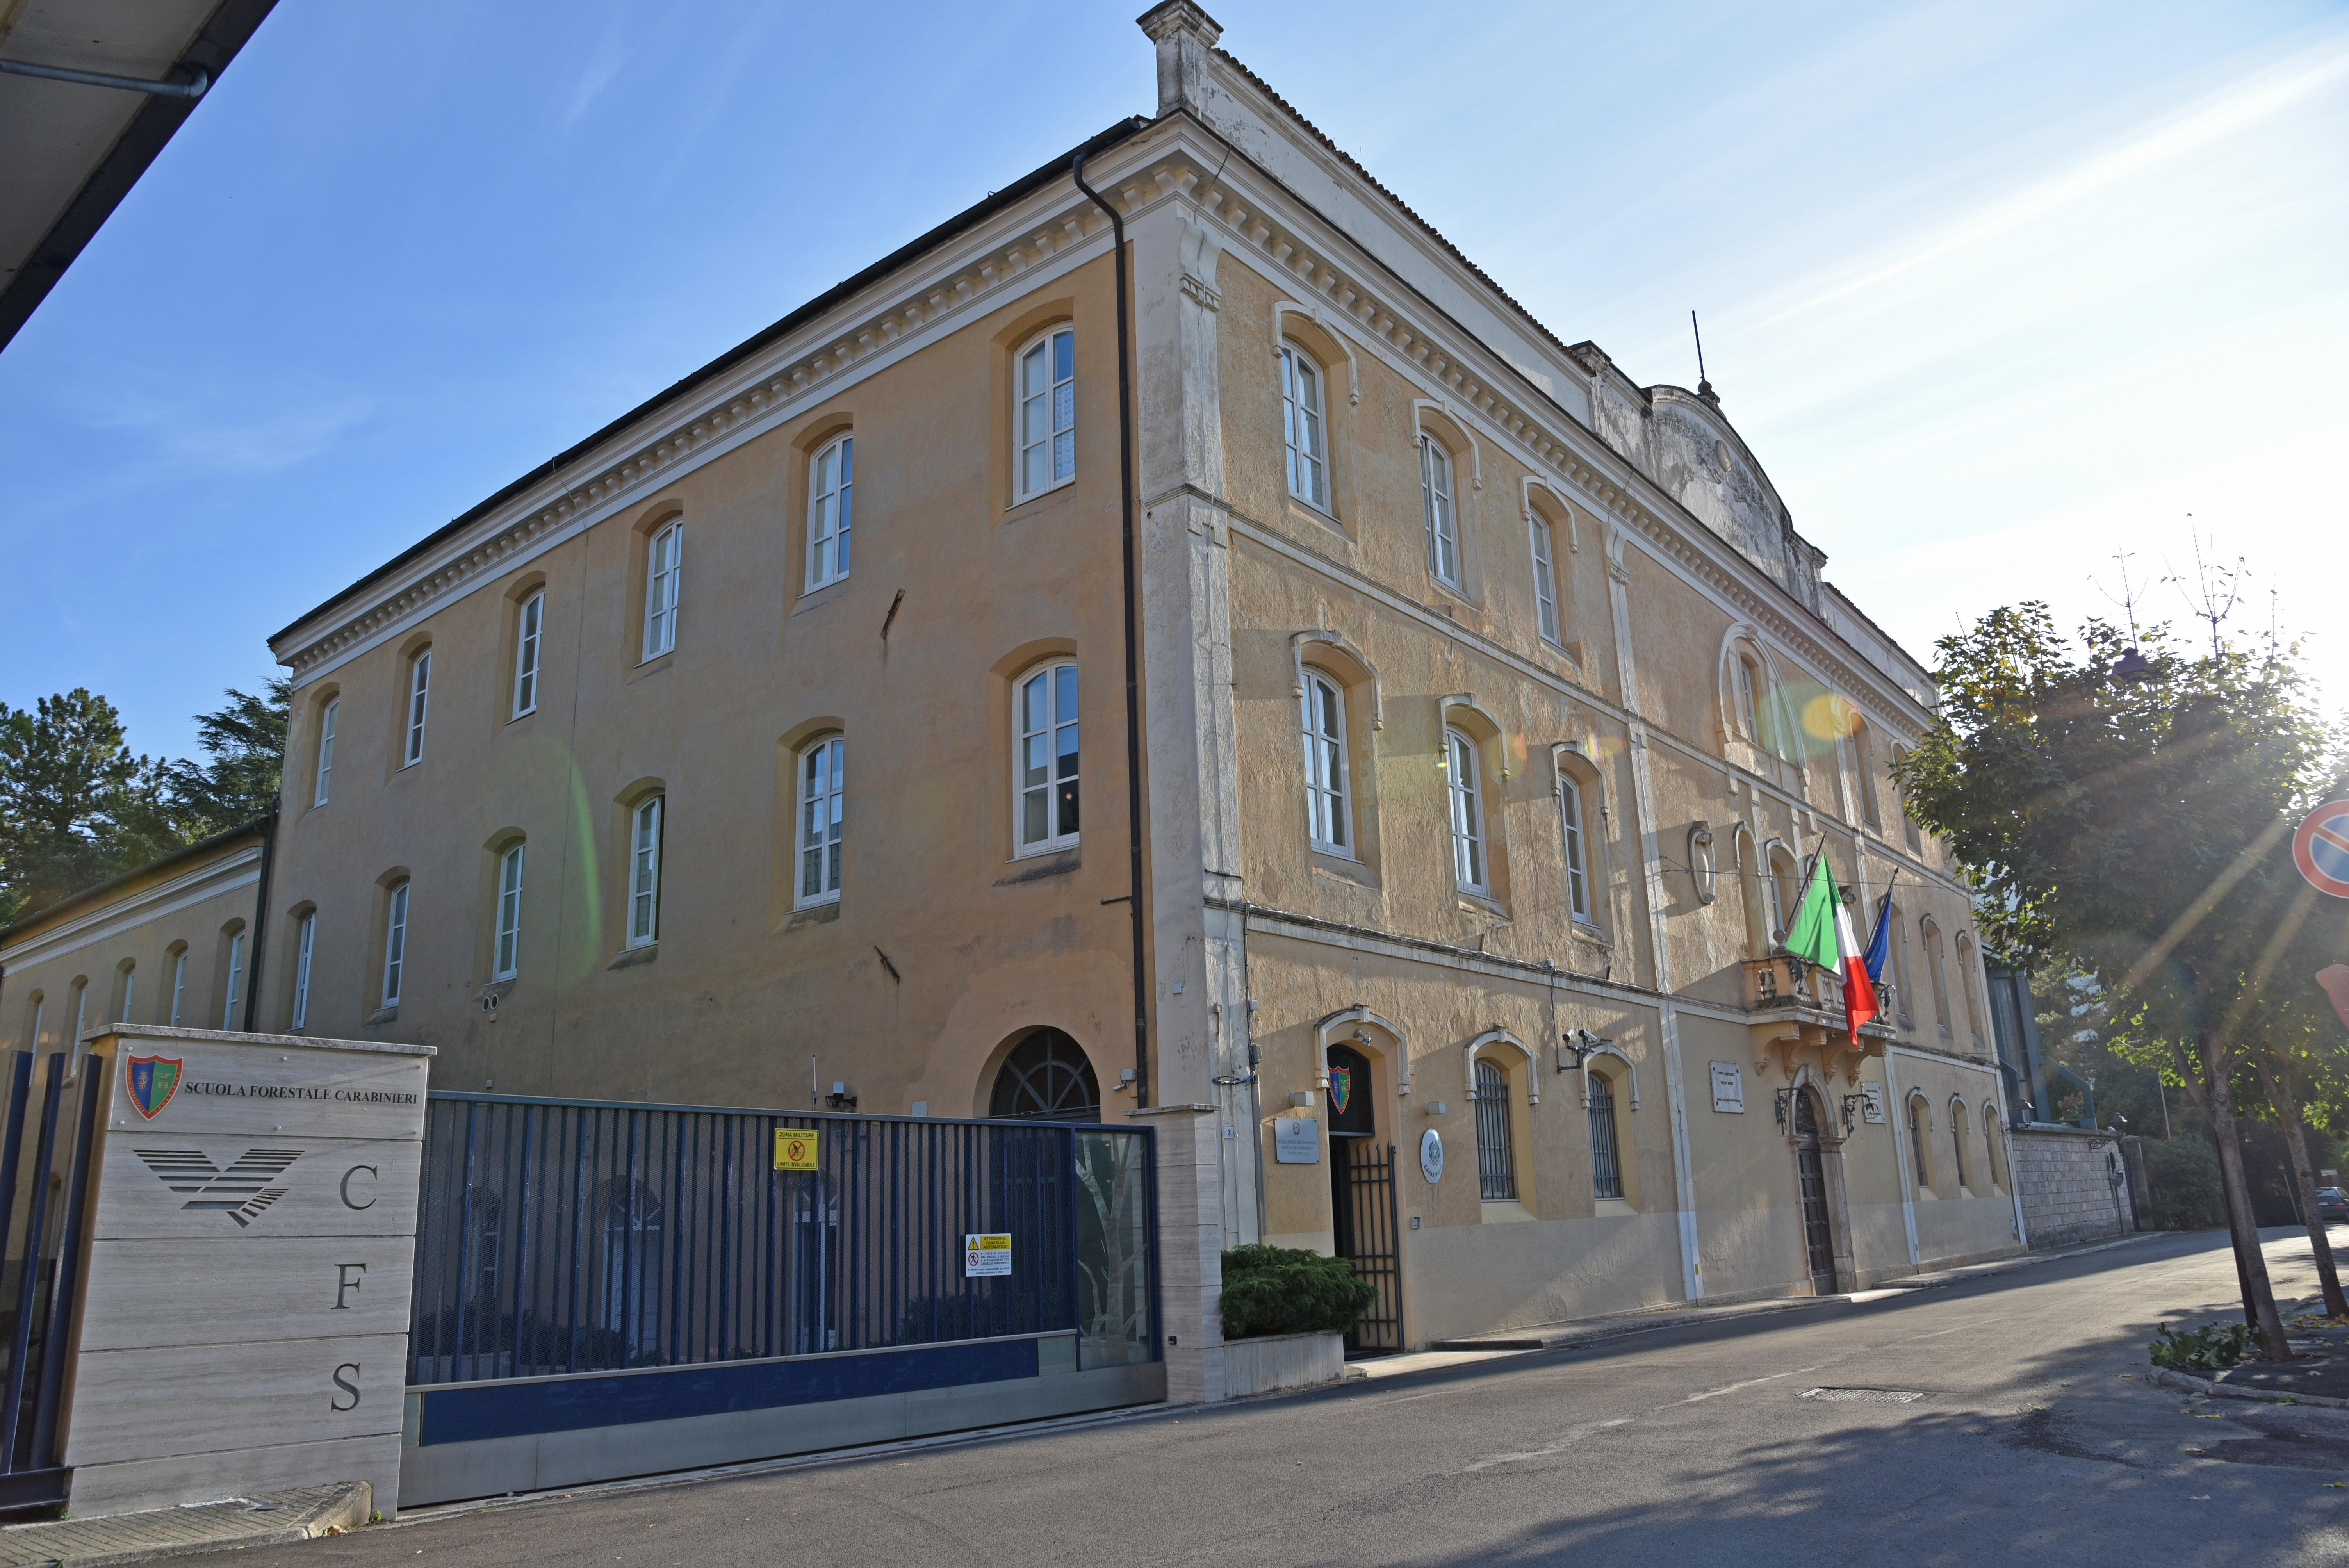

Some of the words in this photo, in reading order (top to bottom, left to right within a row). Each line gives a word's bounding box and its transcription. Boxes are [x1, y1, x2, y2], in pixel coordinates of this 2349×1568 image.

[129, 1087, 145, 1113] FORESTALE
[154, 1068, 181, 1113] CARABINIERI
[185, 1082, 246, 1096] SCUOLA
[250, 1085, 331, 1100] FORESTALE
[335, 1090, 418, 1104] CARABINIERI
[340, 1165, 378, 1210] C
[1424, 1164, 1442, 1178] CARABINIERI
[331, 1263, 367, 1310] F
[331, 1362, 361, 1412] S
